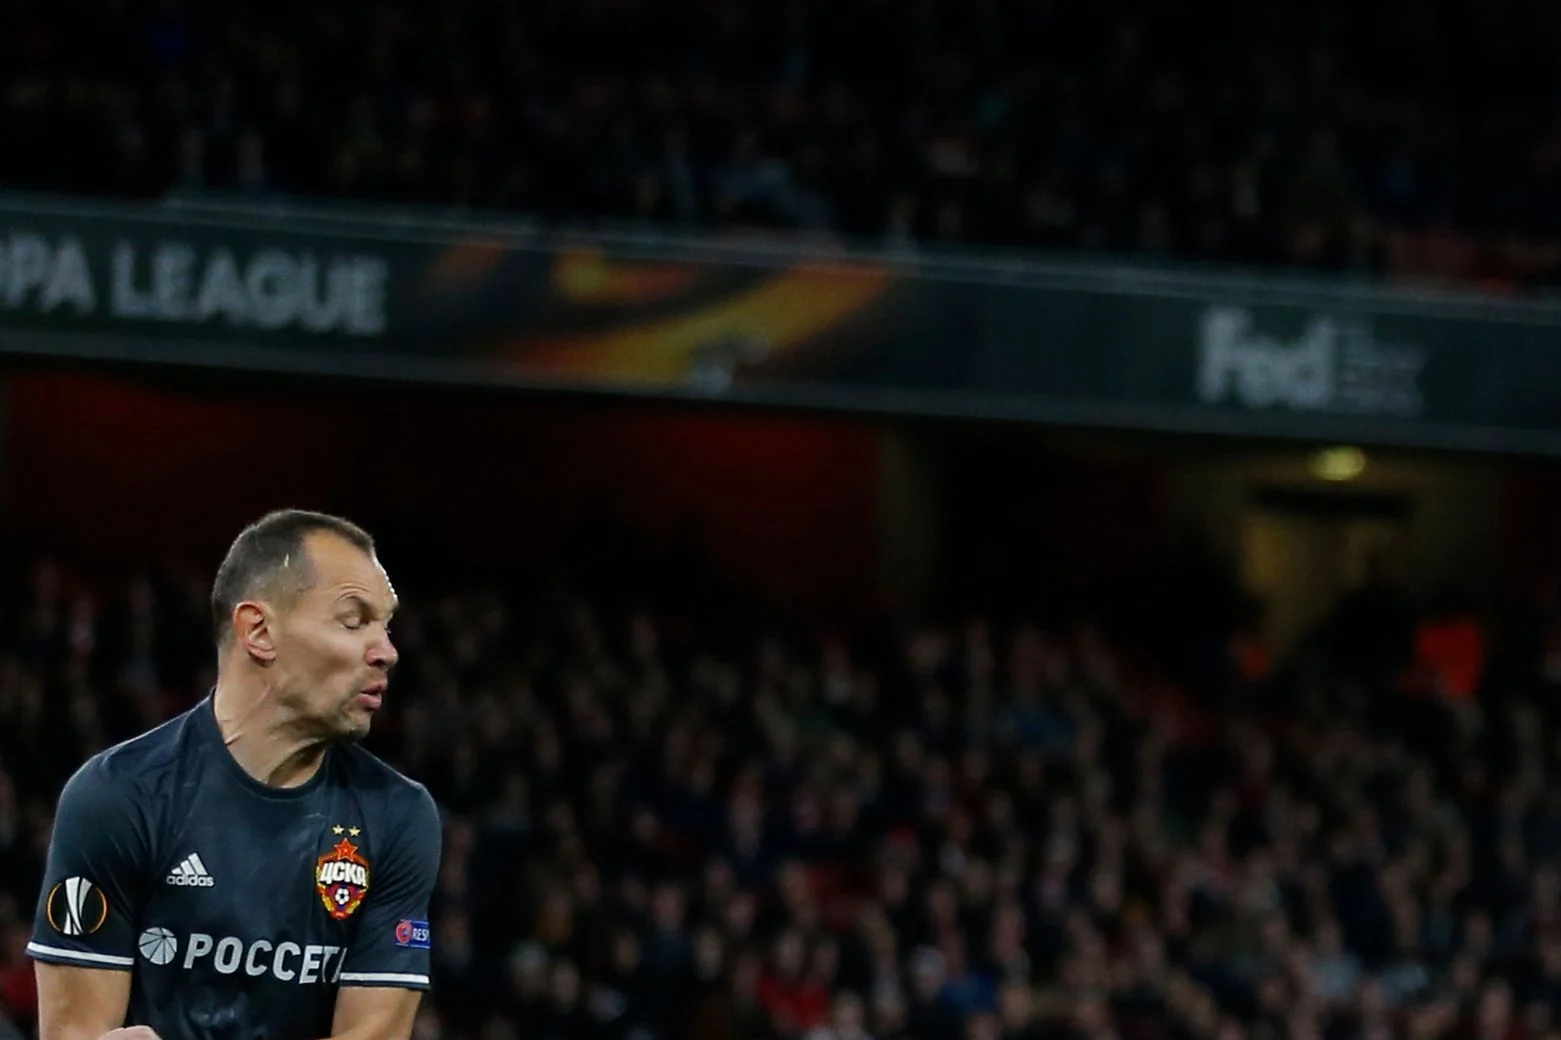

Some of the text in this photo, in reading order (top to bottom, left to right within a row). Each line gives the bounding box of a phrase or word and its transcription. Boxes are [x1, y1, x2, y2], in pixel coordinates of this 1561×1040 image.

[0, 231, 387, 335] PA LEAGUE
[166, 873, 215, 887] adidas
[320, 861, 367, 887] ЦСКА
